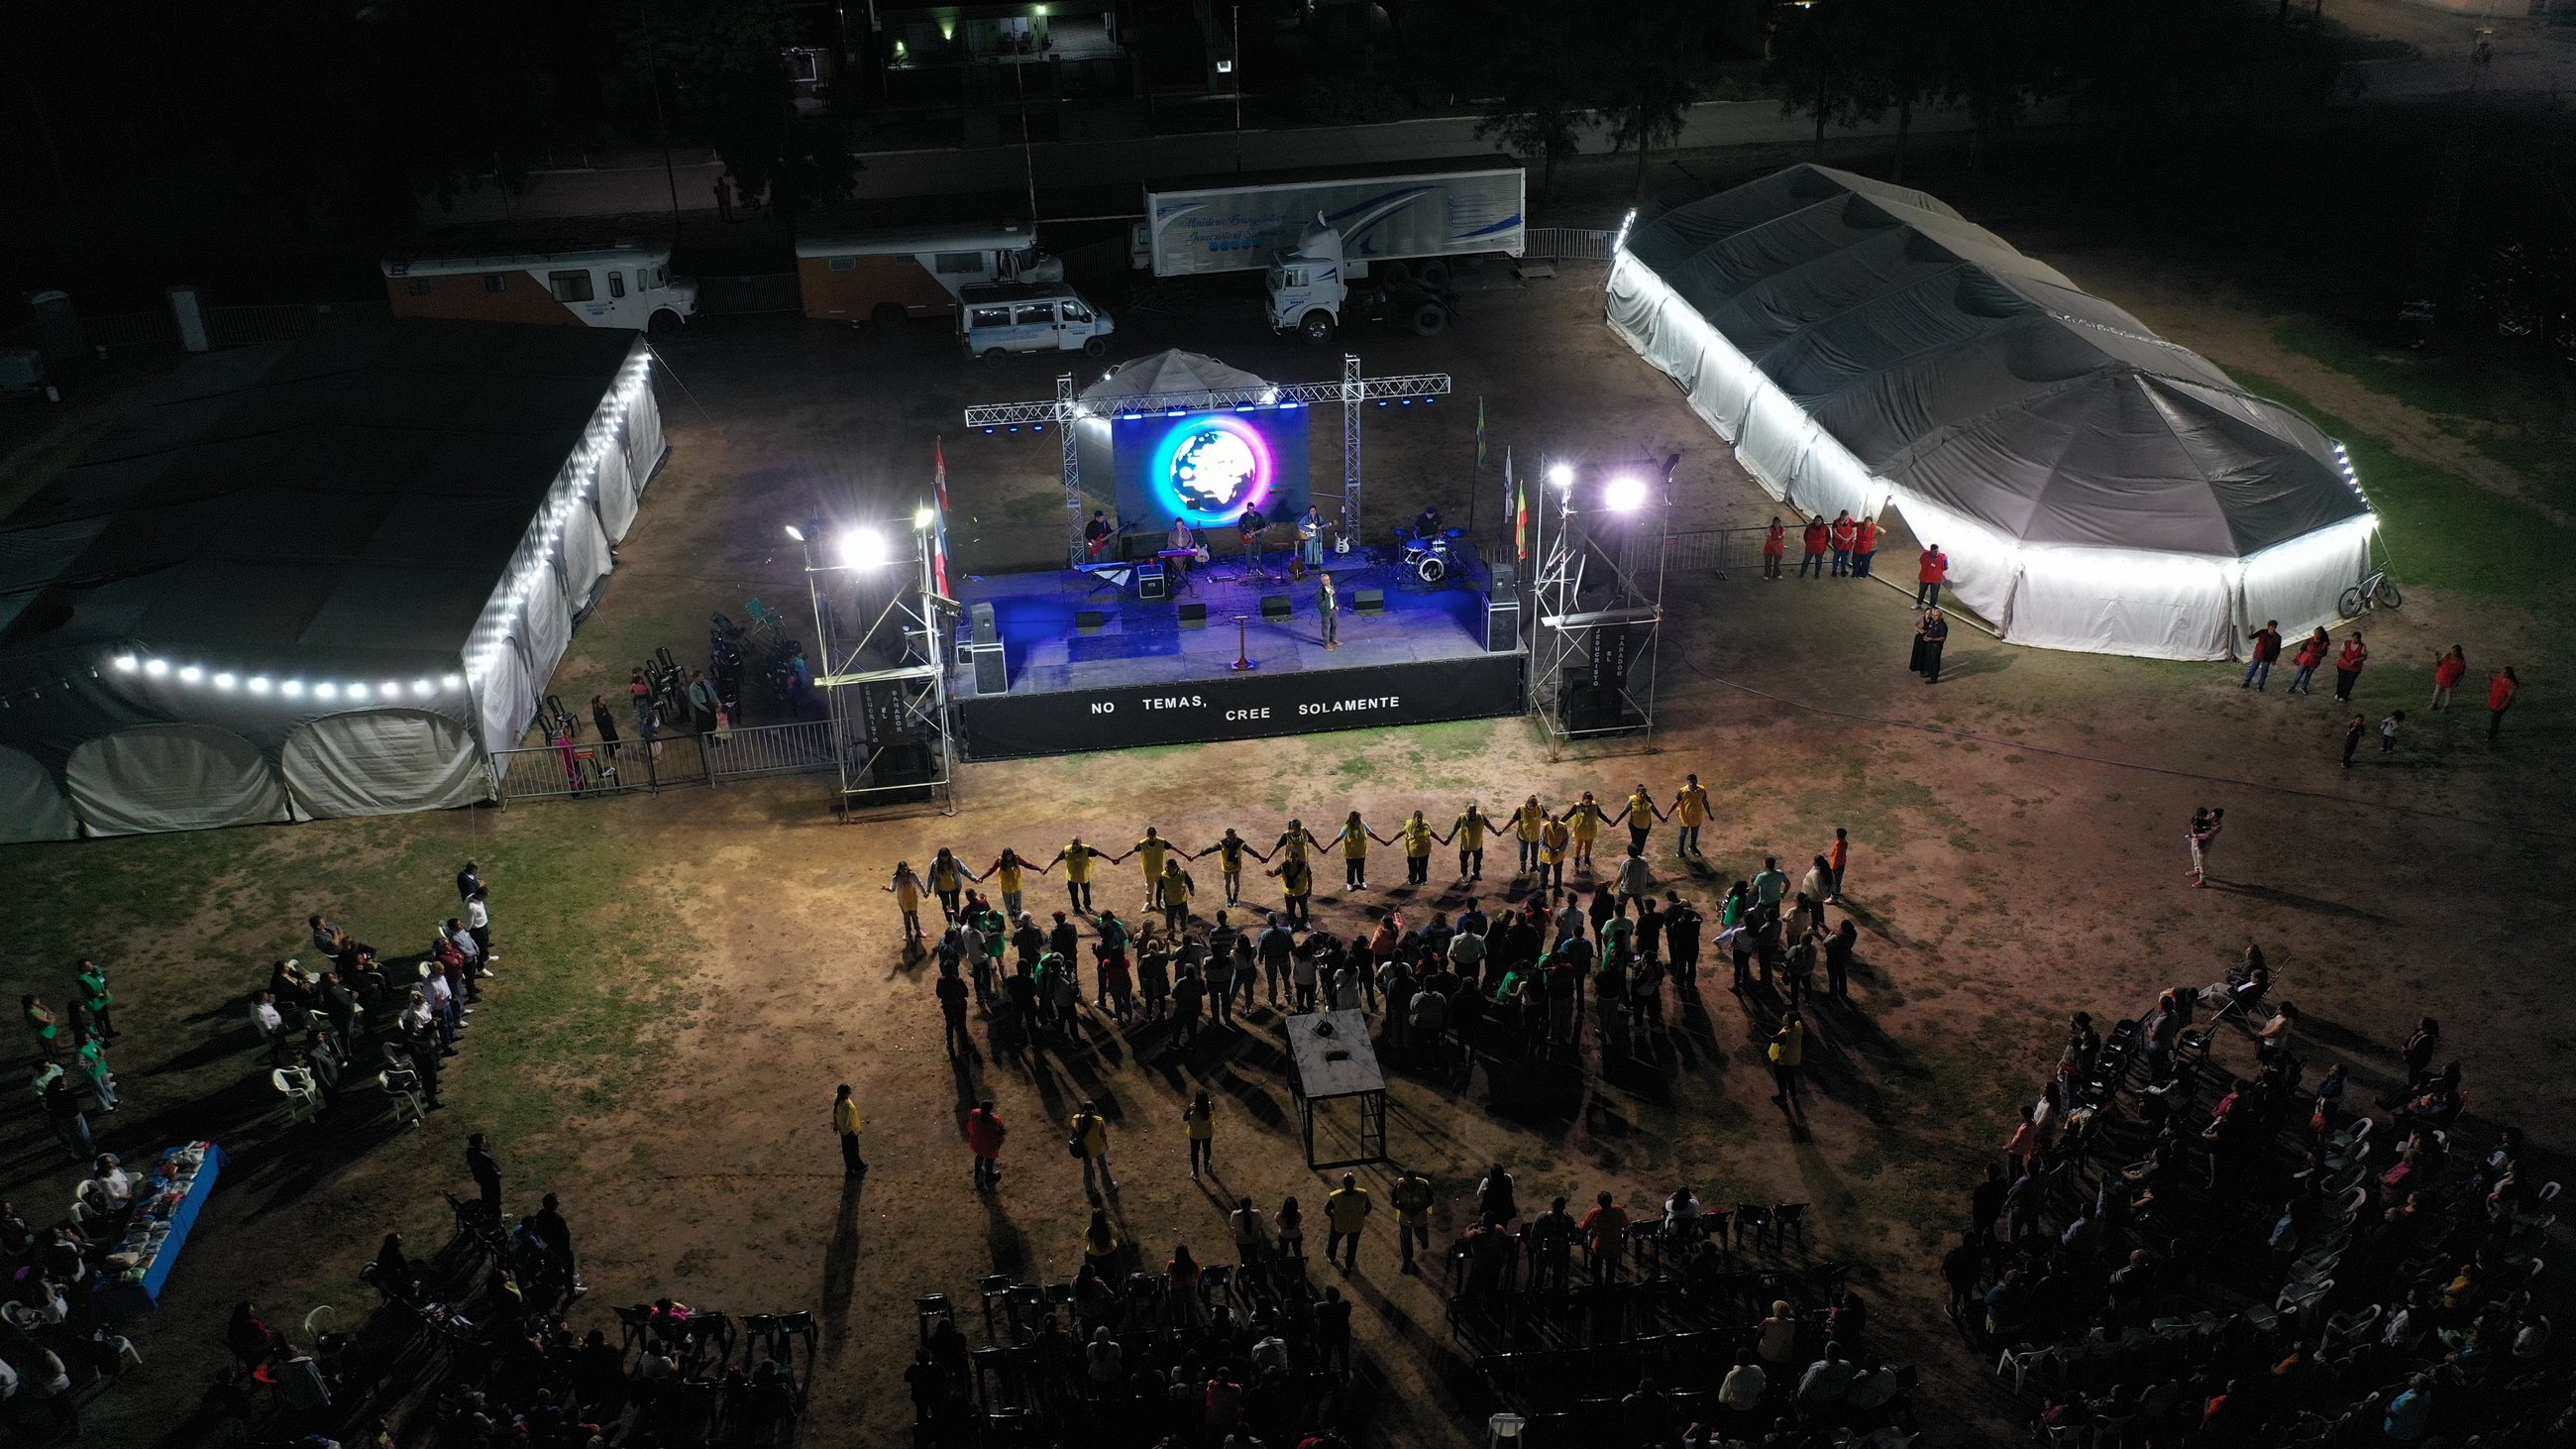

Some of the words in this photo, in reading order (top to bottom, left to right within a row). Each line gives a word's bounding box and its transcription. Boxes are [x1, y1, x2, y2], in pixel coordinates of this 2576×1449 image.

[1592, 628, 1601, 687] JESUCRISTO
[1606, 650, 1612, 662] EL
[865, 684, 879, 742] JESUCRISTO
[881, 707, 888, 719] EL
[892, 690, 903, 732] SANADOR
[1091, 702, 1116, 715] NO
[1142, 695, 1207, 710] TEMAS,
[1226, 707, 1270, 721] CREE
[1298, 696, 1401, 716] SOLAMENTE
